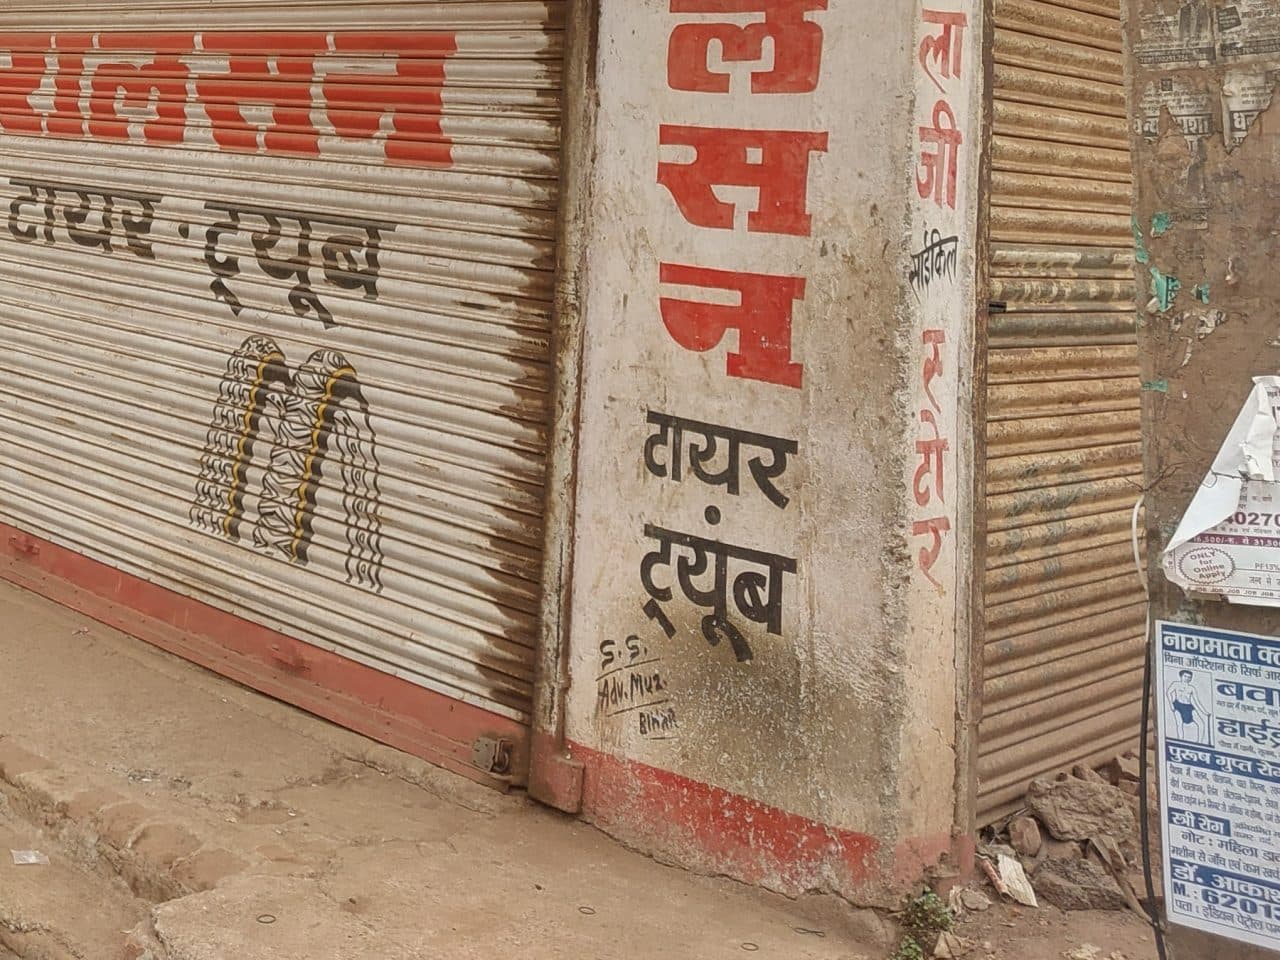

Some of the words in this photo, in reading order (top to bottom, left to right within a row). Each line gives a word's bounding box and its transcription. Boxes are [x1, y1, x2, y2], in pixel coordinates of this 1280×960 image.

[7, 177, 167, 261] टायर
[643, 409, 799, 510] टायर
[1190, 550, 1217, 561] ONLY
[1193, 563, 1226, 574] Online
[1199, 570, 1227, 581] Apply
[1162, 631, 1253, 662] नागमाता
[1163, 651, 1184, 666] बिना
[1185, 654, 1226, 673] ऑपरेशन
[1227, 660, 1238, 674] के
[1198, 815, 1226, 834] रोग
[1217, 838, 1259, 858] महिला
[1243, 861, 1261, 875] कम
